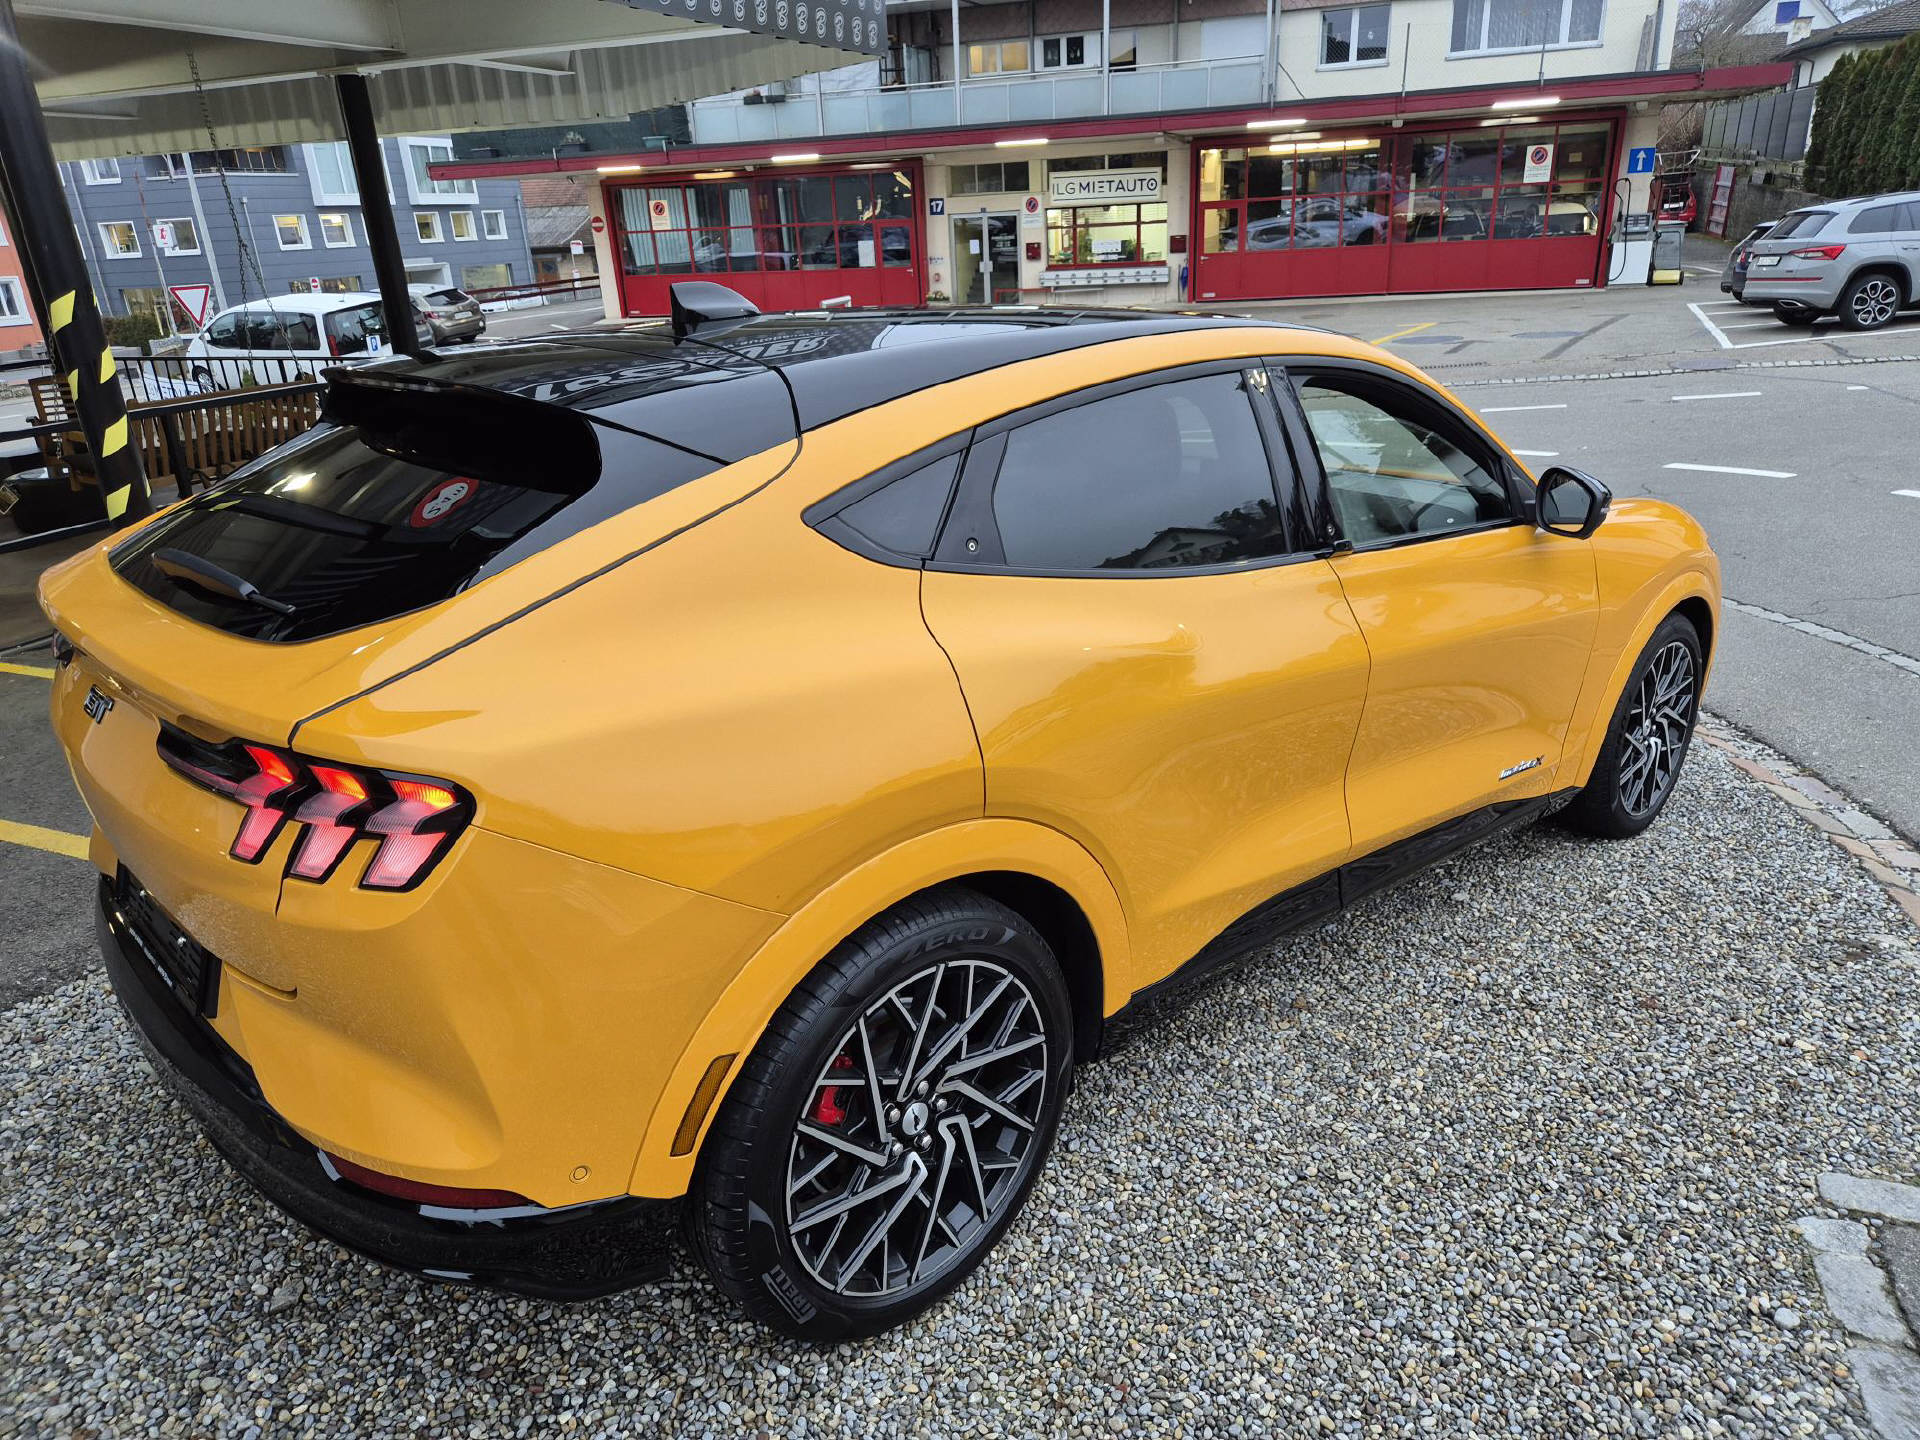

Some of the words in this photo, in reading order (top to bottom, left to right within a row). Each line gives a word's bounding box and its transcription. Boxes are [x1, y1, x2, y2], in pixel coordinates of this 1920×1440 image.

[1052, 182, 1076, 196] ILG
[1079, 178, 1158, 194] MIETAUTO
[930, 200, 944, 213] 17
[902, 927, 990, 963] ZERO
